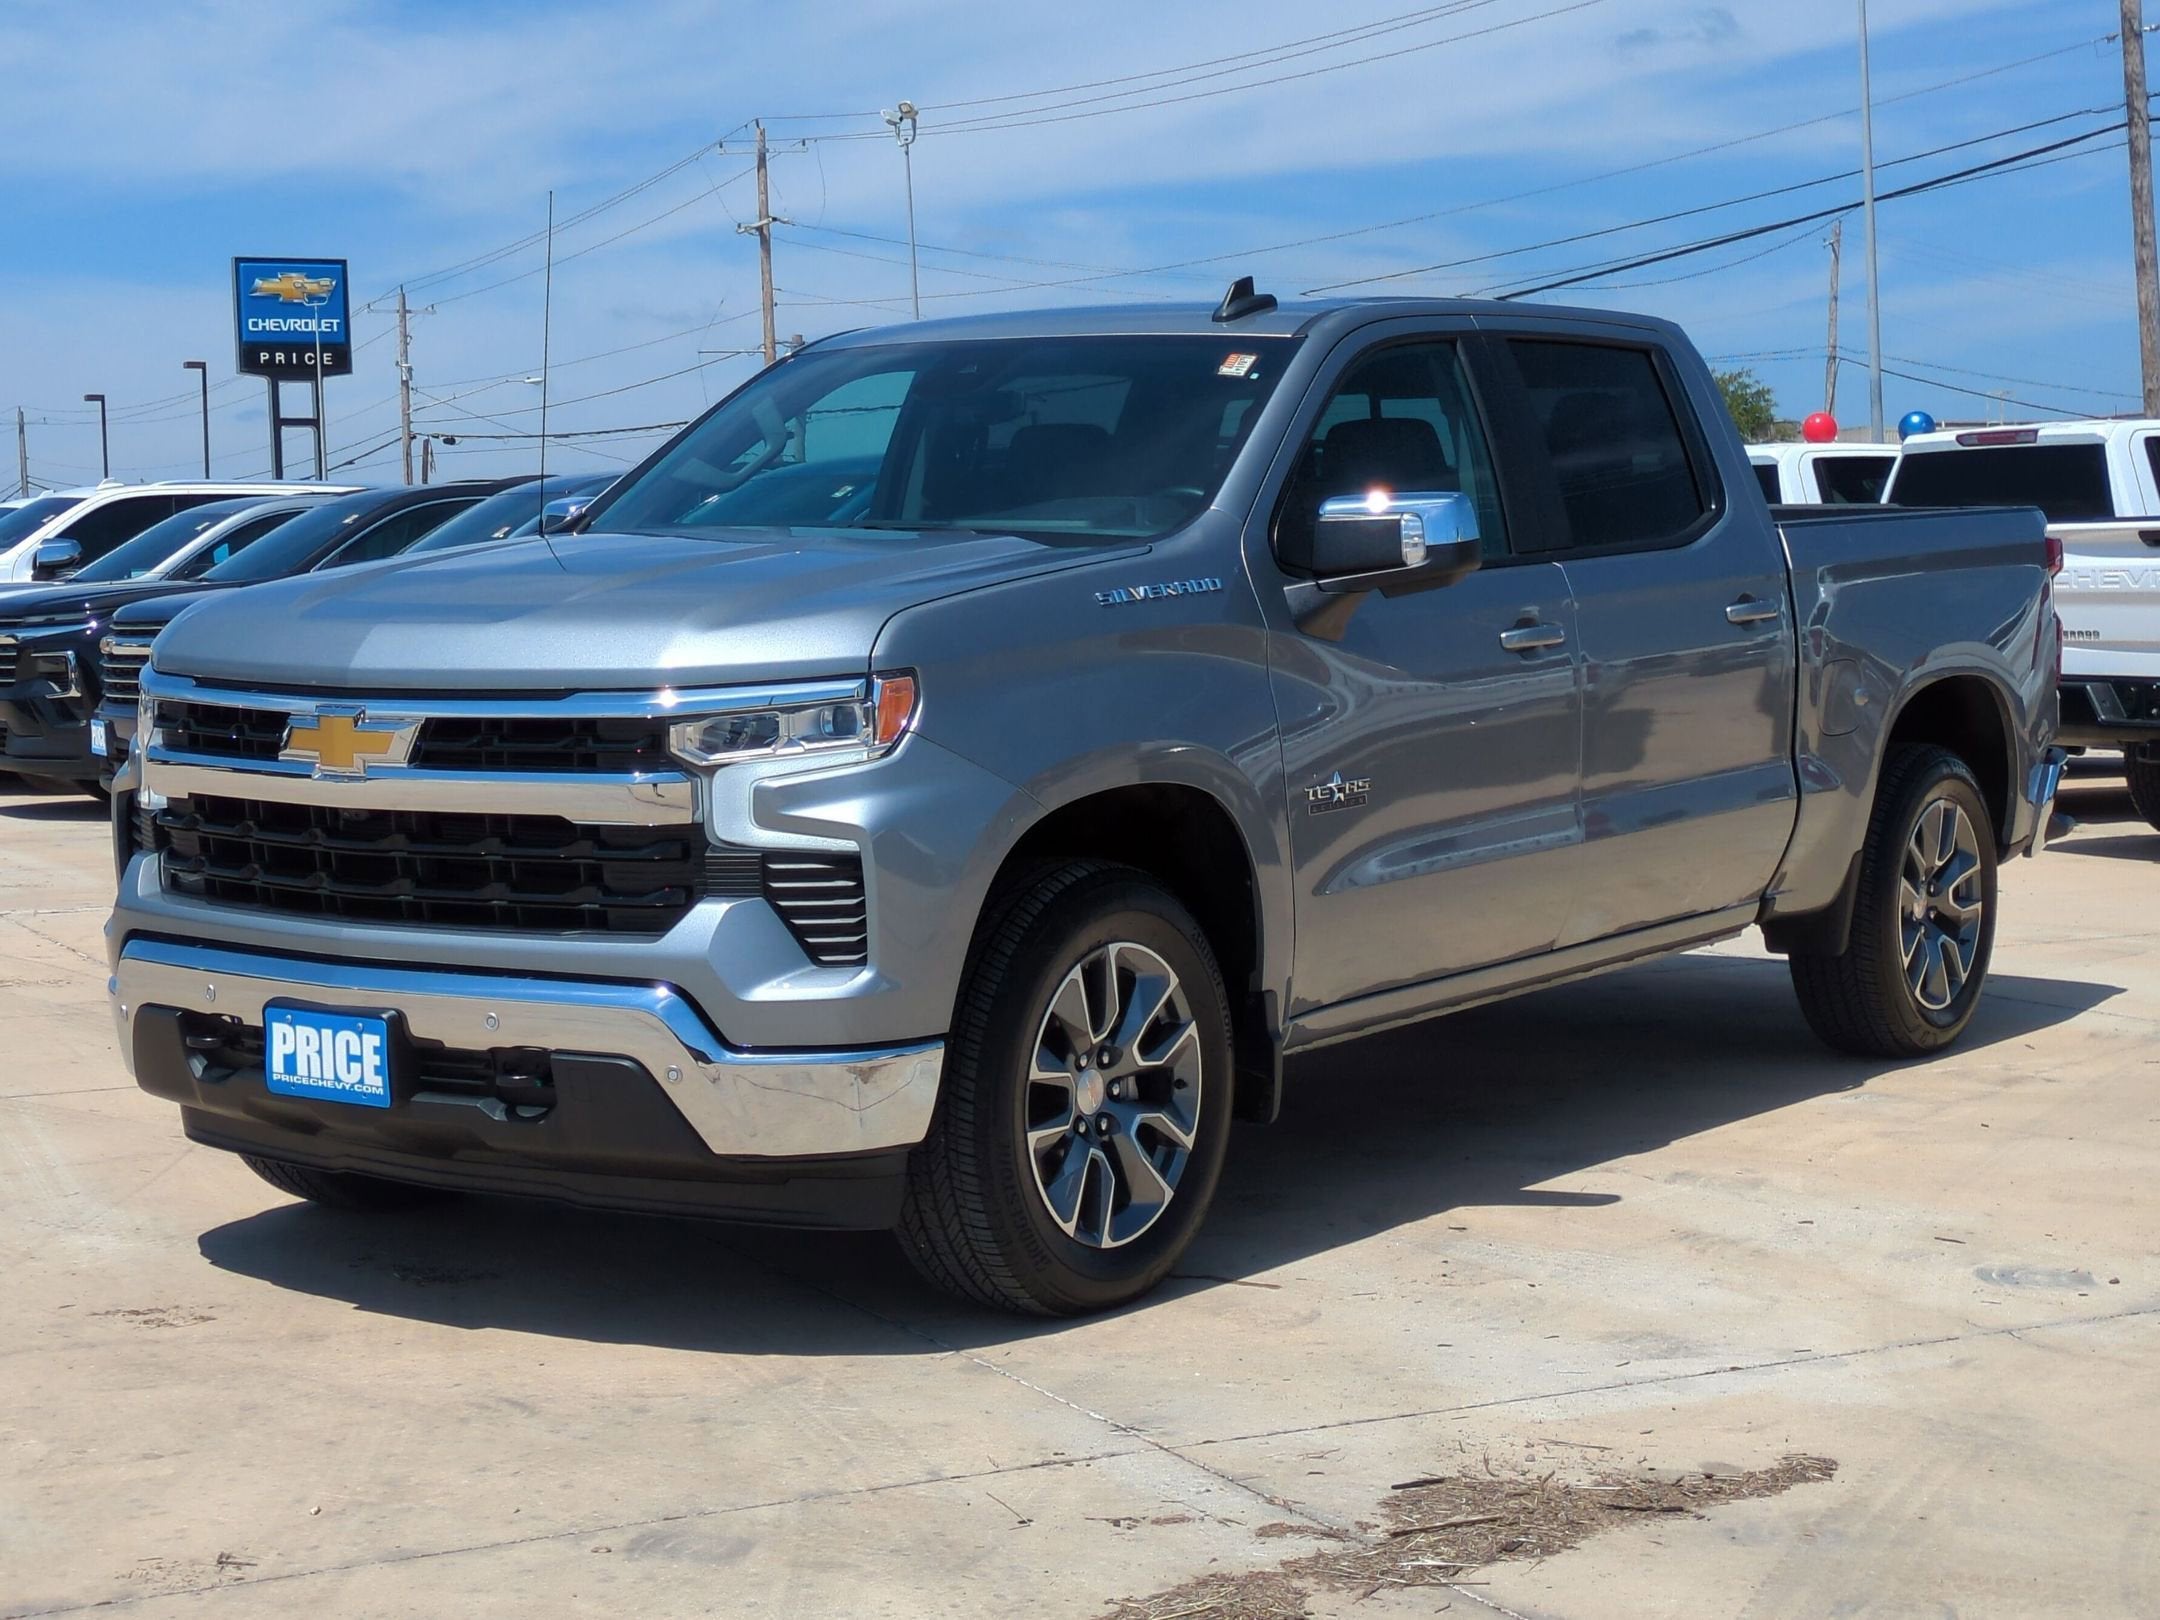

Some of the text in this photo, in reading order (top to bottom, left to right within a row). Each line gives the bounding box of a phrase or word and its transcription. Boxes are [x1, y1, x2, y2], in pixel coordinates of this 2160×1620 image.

[248, 318, 340, 332] CHEVROLET
[260, 352, 333, 365] PRICE
[1095, 578, 1222, 606] SILVERADO
[272, 1021, 383, 1087] PRICE
[273, 1073, 384, 1095] PRICECHEVY.COM
